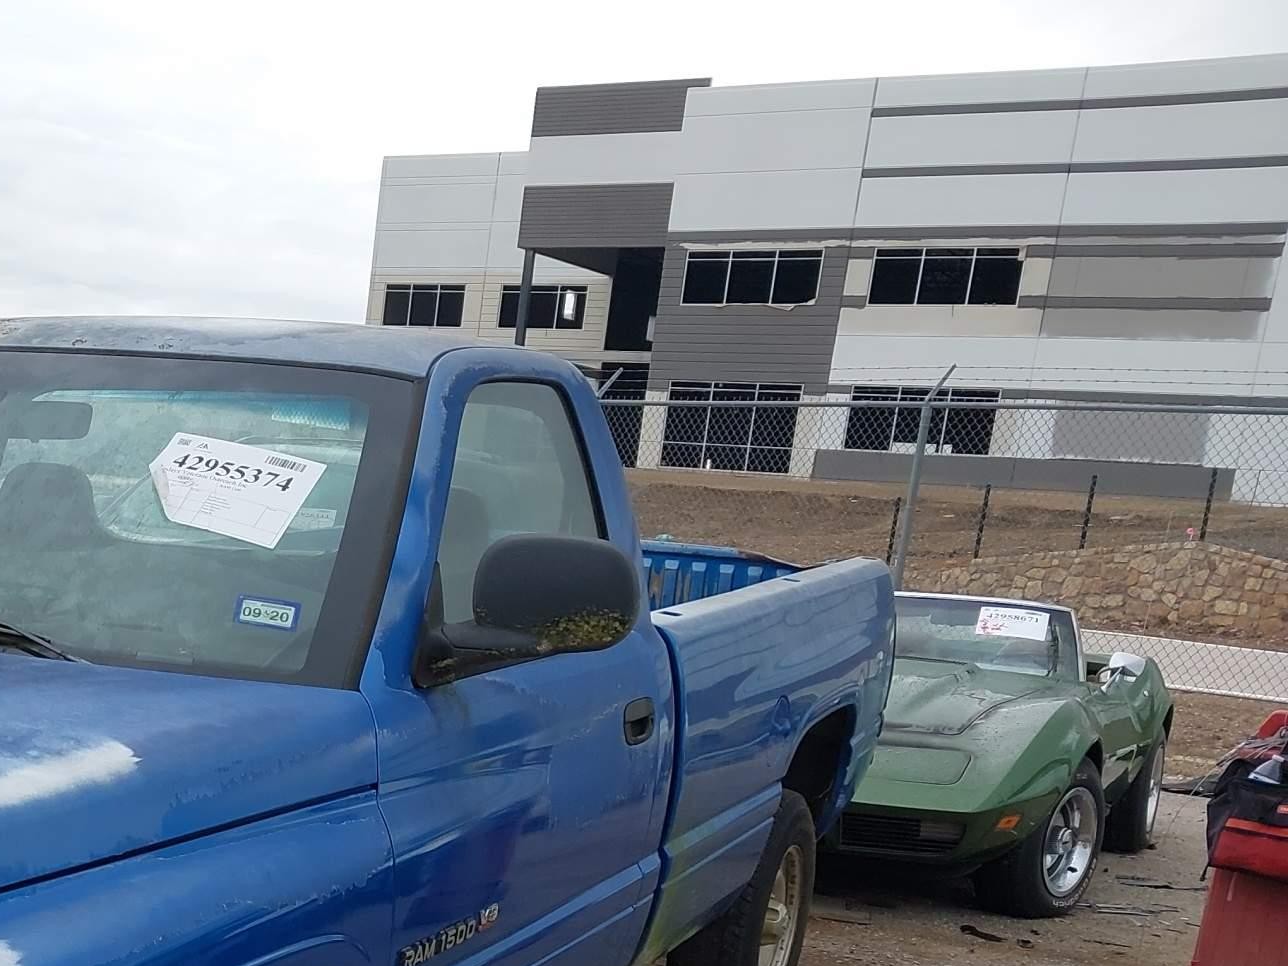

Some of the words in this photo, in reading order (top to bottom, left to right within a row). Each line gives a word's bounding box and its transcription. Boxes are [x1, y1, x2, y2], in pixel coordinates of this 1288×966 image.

[172, 453, 295, 492] 42955374
[243, 606, 262, 618] 09
[269, 610, 290, 623] 20
[986, 612, 1040, 624] 42958671
[439, 917, 477, 953] 1500
